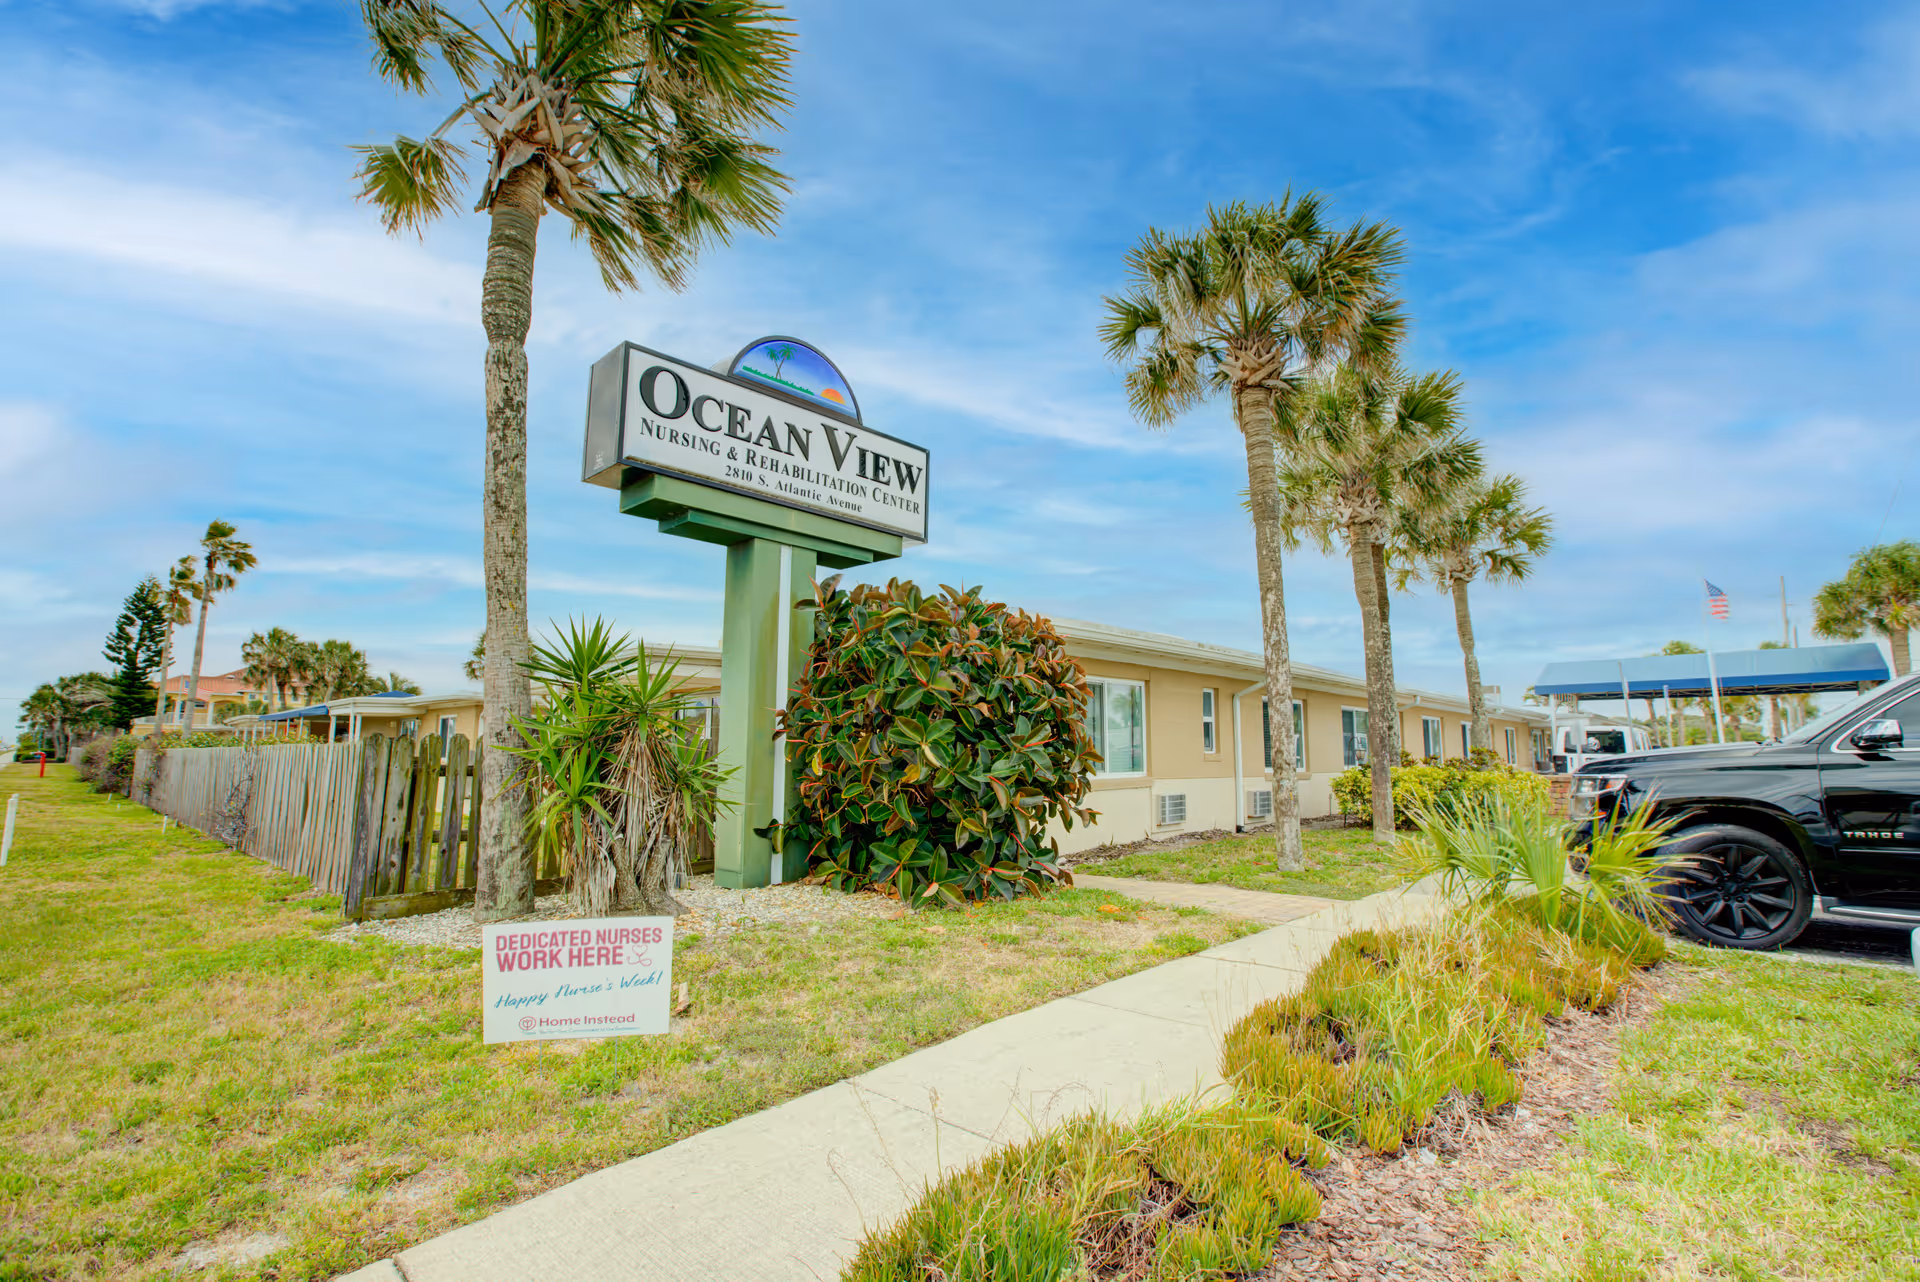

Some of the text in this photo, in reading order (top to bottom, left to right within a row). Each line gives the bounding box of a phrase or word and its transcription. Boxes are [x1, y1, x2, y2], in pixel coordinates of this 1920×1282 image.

[639, 365, 923, 494] OCEAN VIEW
[640, 417, 920, 514] NURSING & REHABILITATION CENTER
[725, 465, 862, 512] 2810 S. Atlantic Avenue
[1843, 831, 1904, 839] TAHOE
[496, 927, 662, 951] DEDICATED NURSES
[496, 945, 623, 972] WORK HERE
[494, 970, 663, 1009] Happy Nurse's Week!
[539, 1013, 635, 1027] Home Instead
